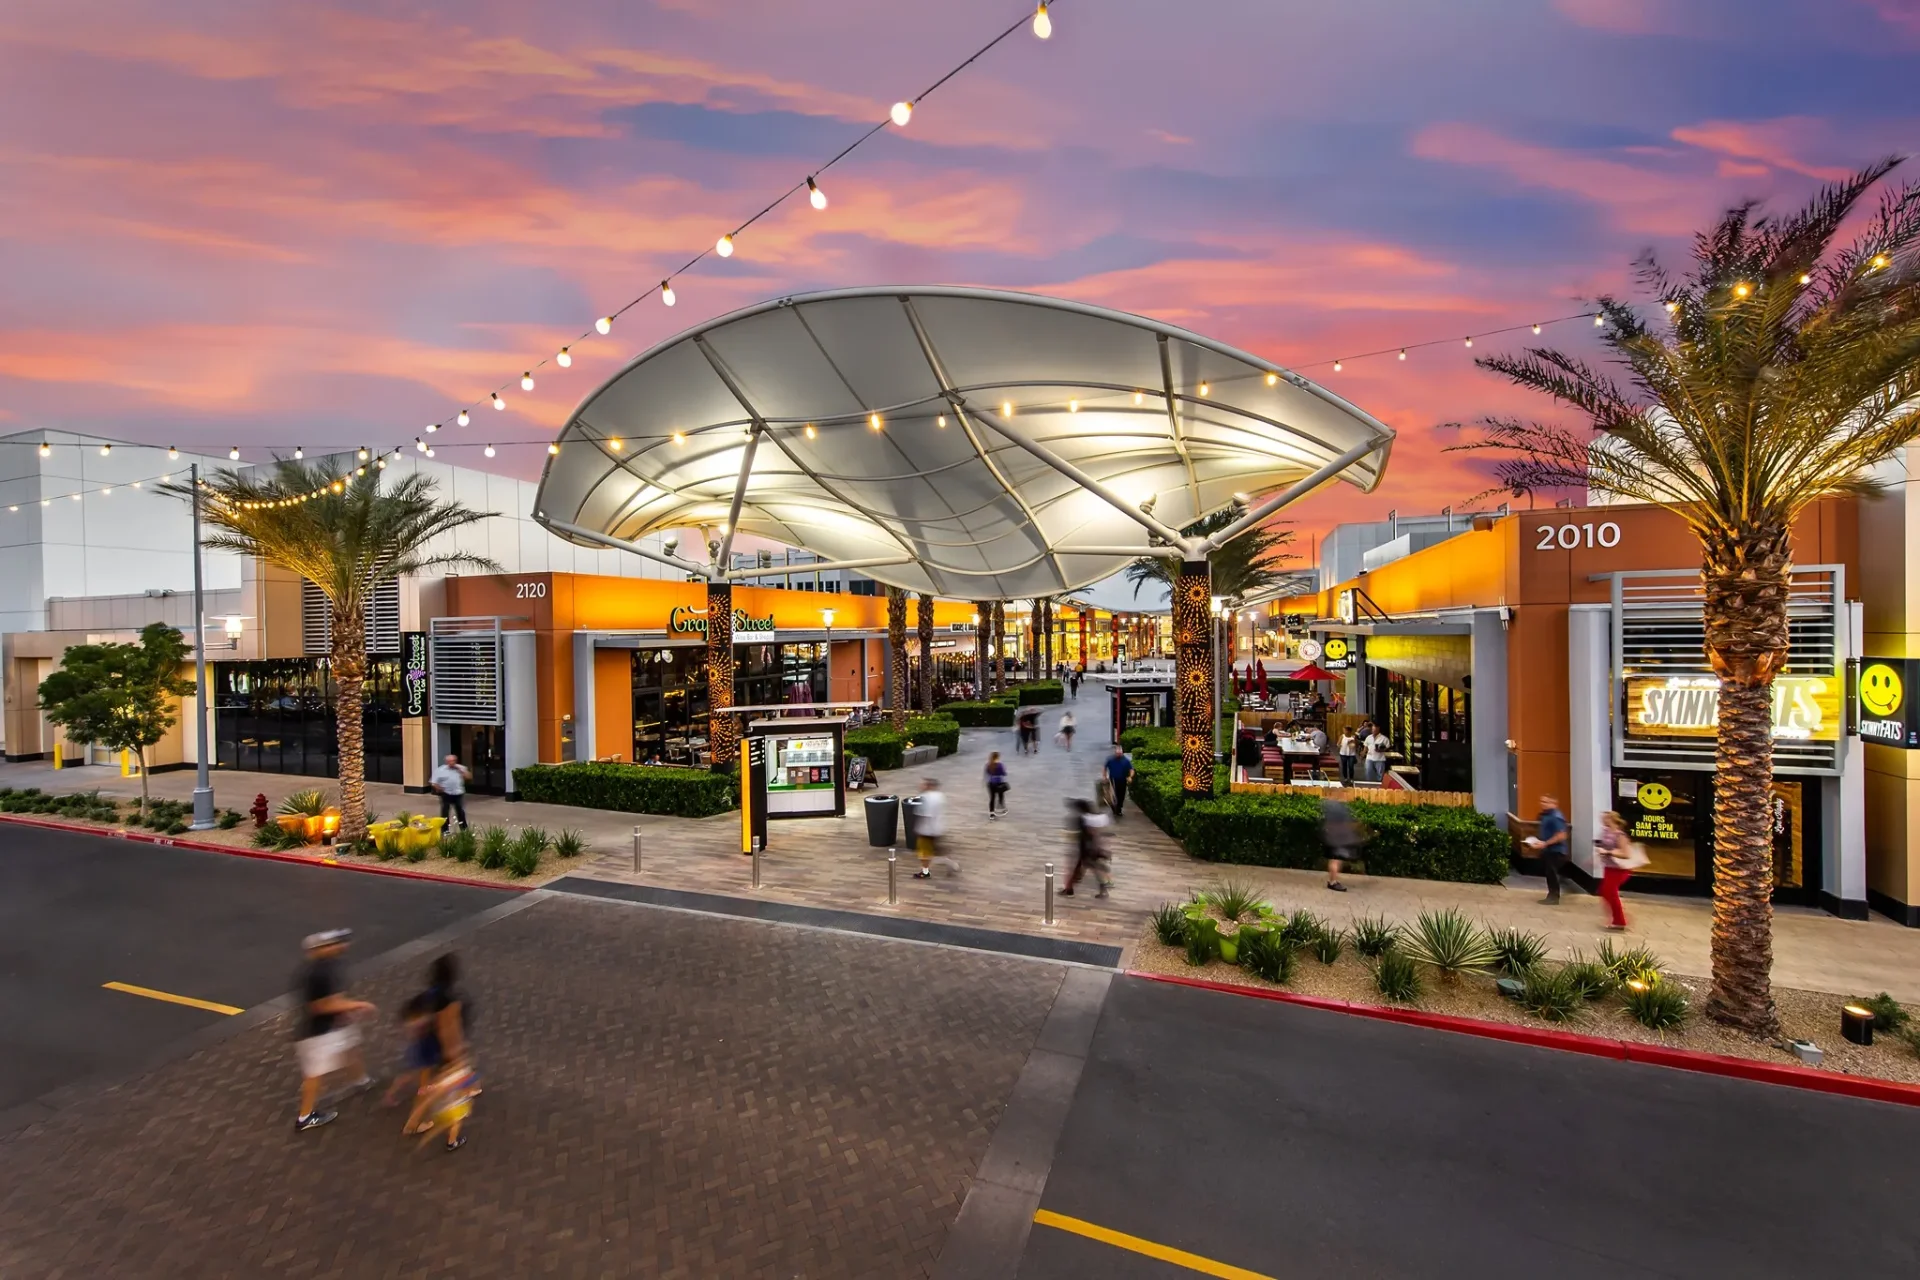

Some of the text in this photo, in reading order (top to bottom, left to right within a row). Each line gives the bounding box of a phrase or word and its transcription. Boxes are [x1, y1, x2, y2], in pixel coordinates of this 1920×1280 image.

[1536, 521, 1621, 550] 2010
[516, 582, 546, 598] 2120
[670, 606, 776, 641] Gra Street
[407, 634, 426, 715] Grape Street
[1636, 822, 1652, 830] 9AM
[1657, 823, 1673, 831] 9PM
[1643, 815, 1665, 823] HOURS
[1660, 831, 1679, 839] WEEK
